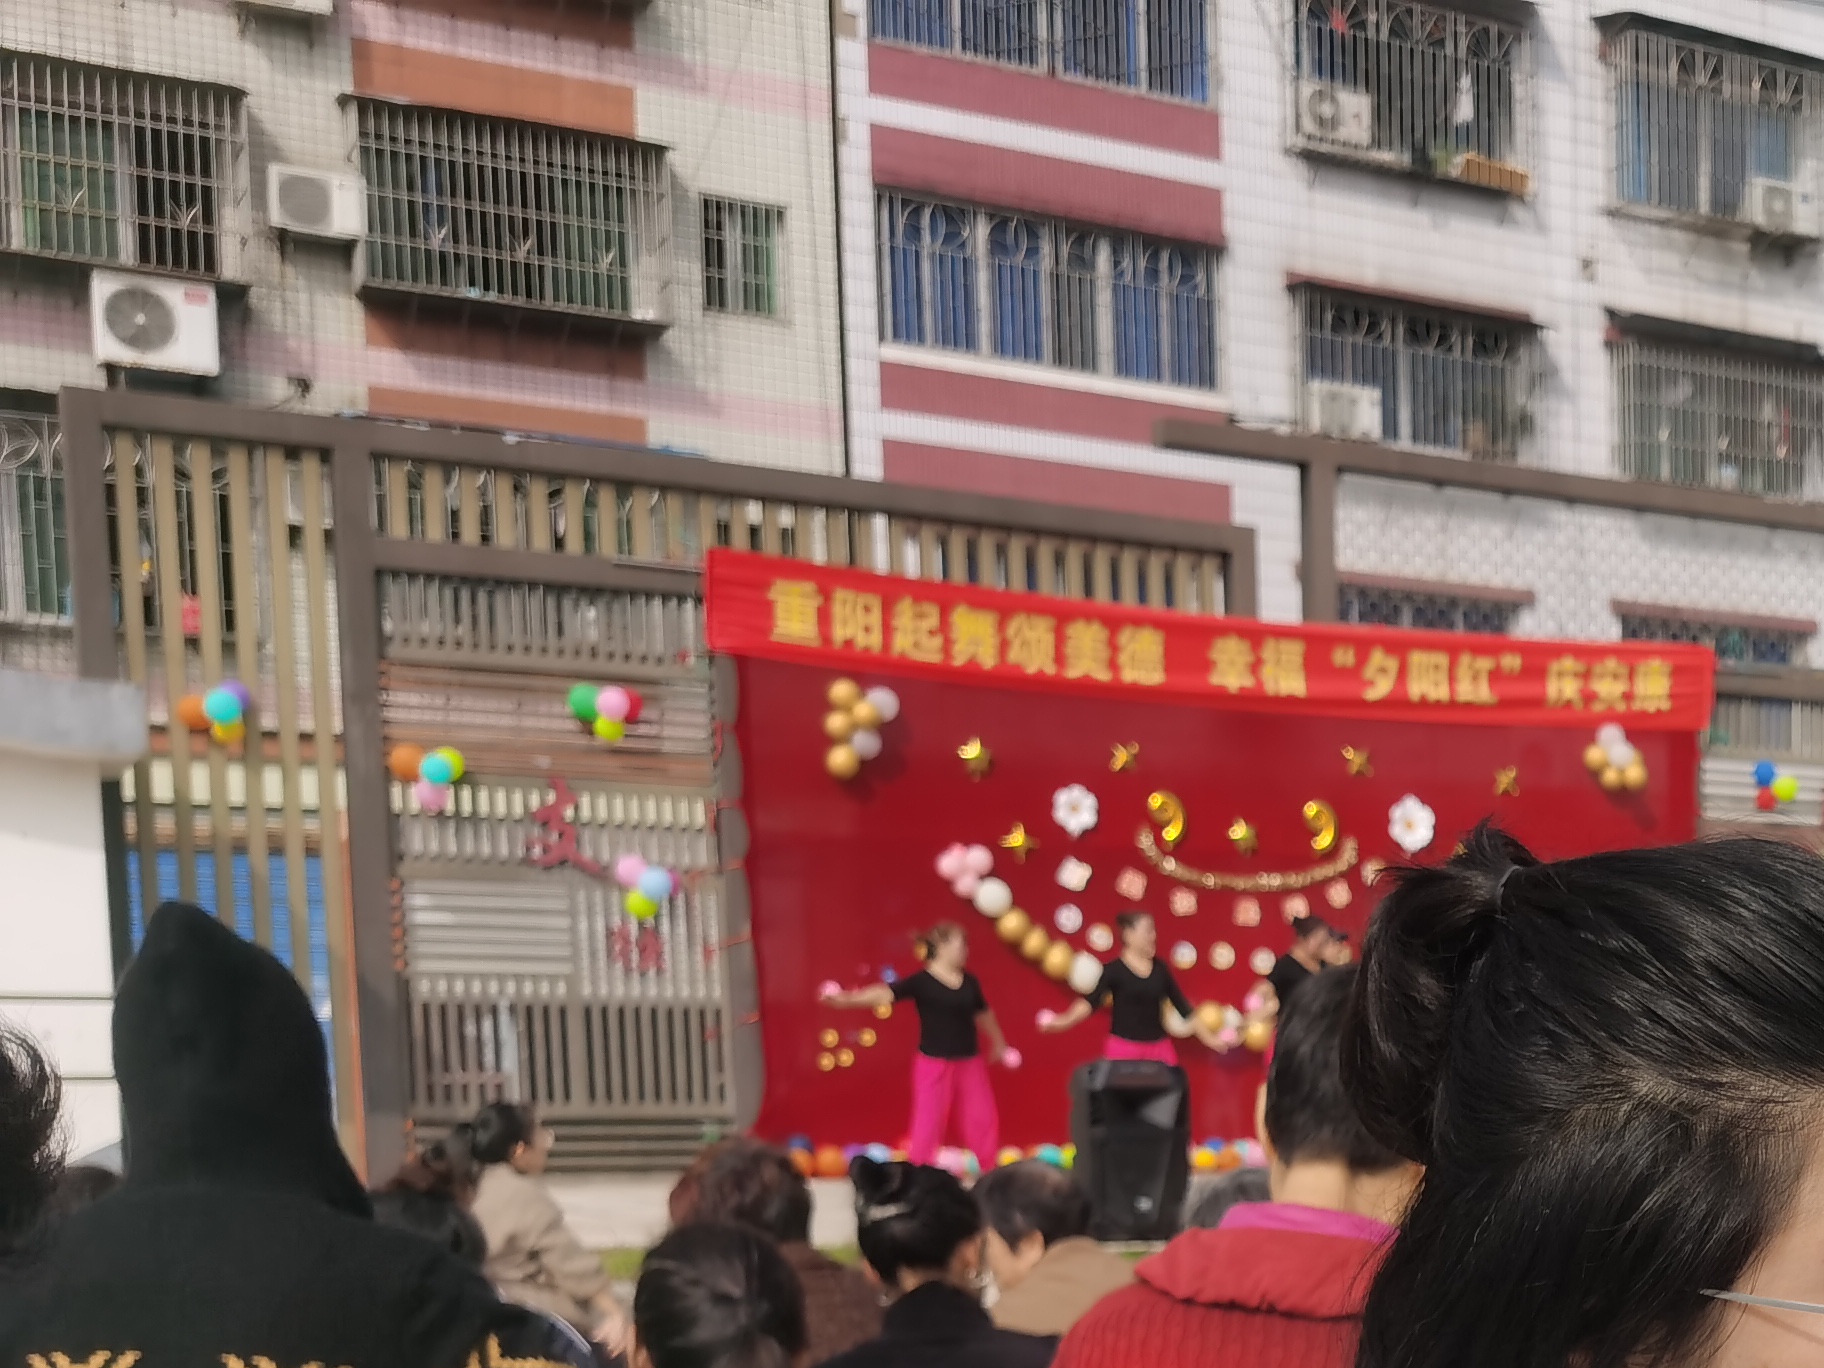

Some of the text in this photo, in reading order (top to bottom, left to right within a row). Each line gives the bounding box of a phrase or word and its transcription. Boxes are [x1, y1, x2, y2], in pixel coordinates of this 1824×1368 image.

[766, 578, 1168, 688] 重阳起舞颂美德
